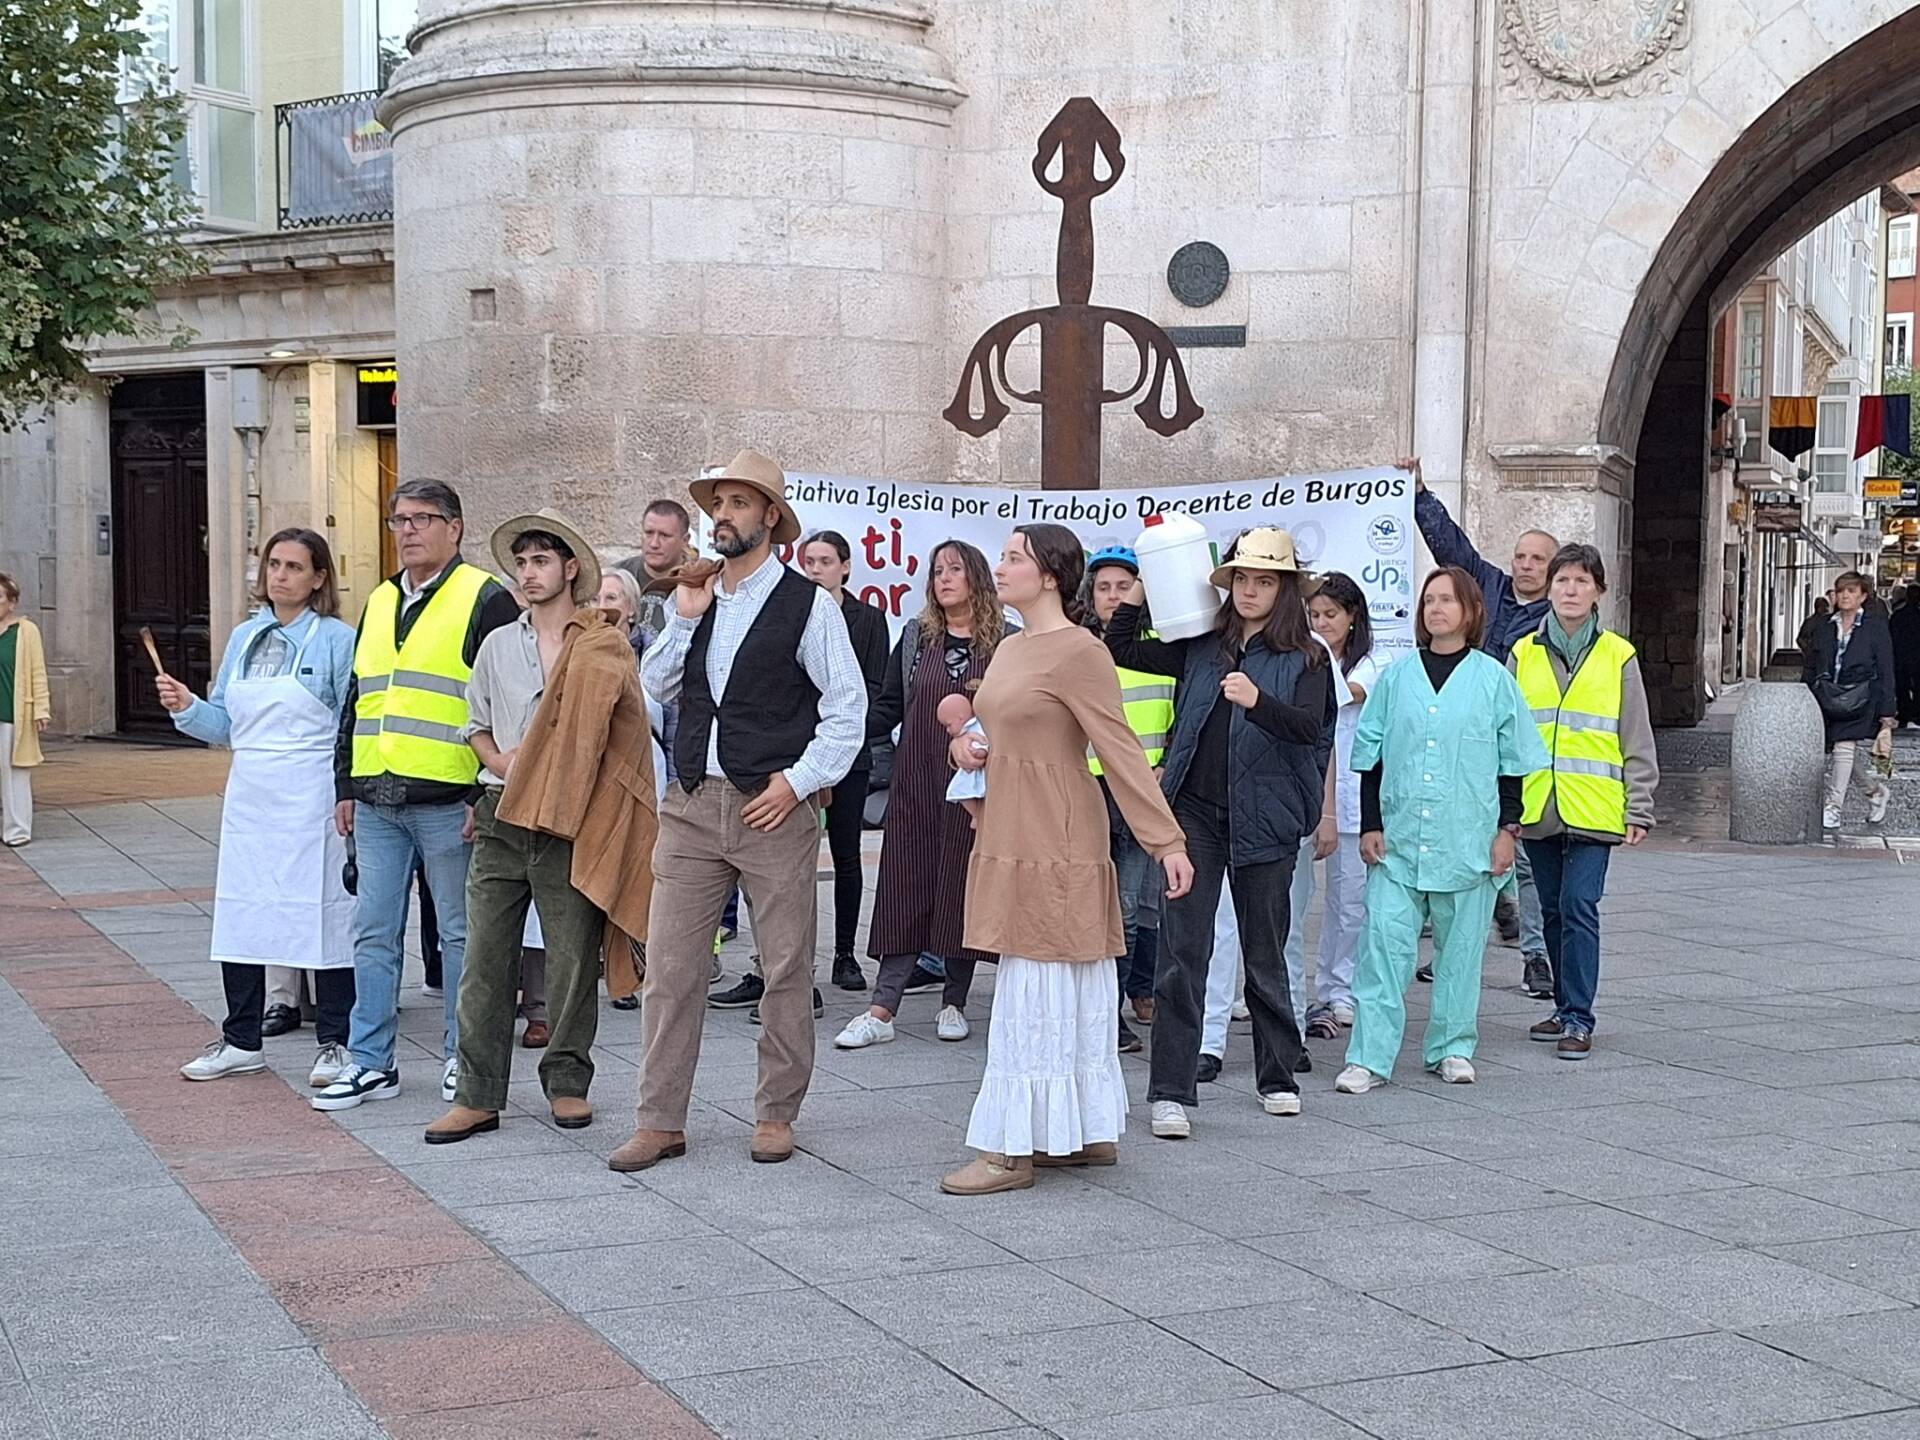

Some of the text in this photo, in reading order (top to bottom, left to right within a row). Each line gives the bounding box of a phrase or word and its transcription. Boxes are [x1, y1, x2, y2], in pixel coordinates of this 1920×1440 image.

[784, 479, 1406, 526] ciativa Iglesia por el Trabajo Decente de Burgos
[1867, 483, 1898, 492] Kodak
[861, 518, 919, 577] ti,
[859, 583, 912, 617] or
